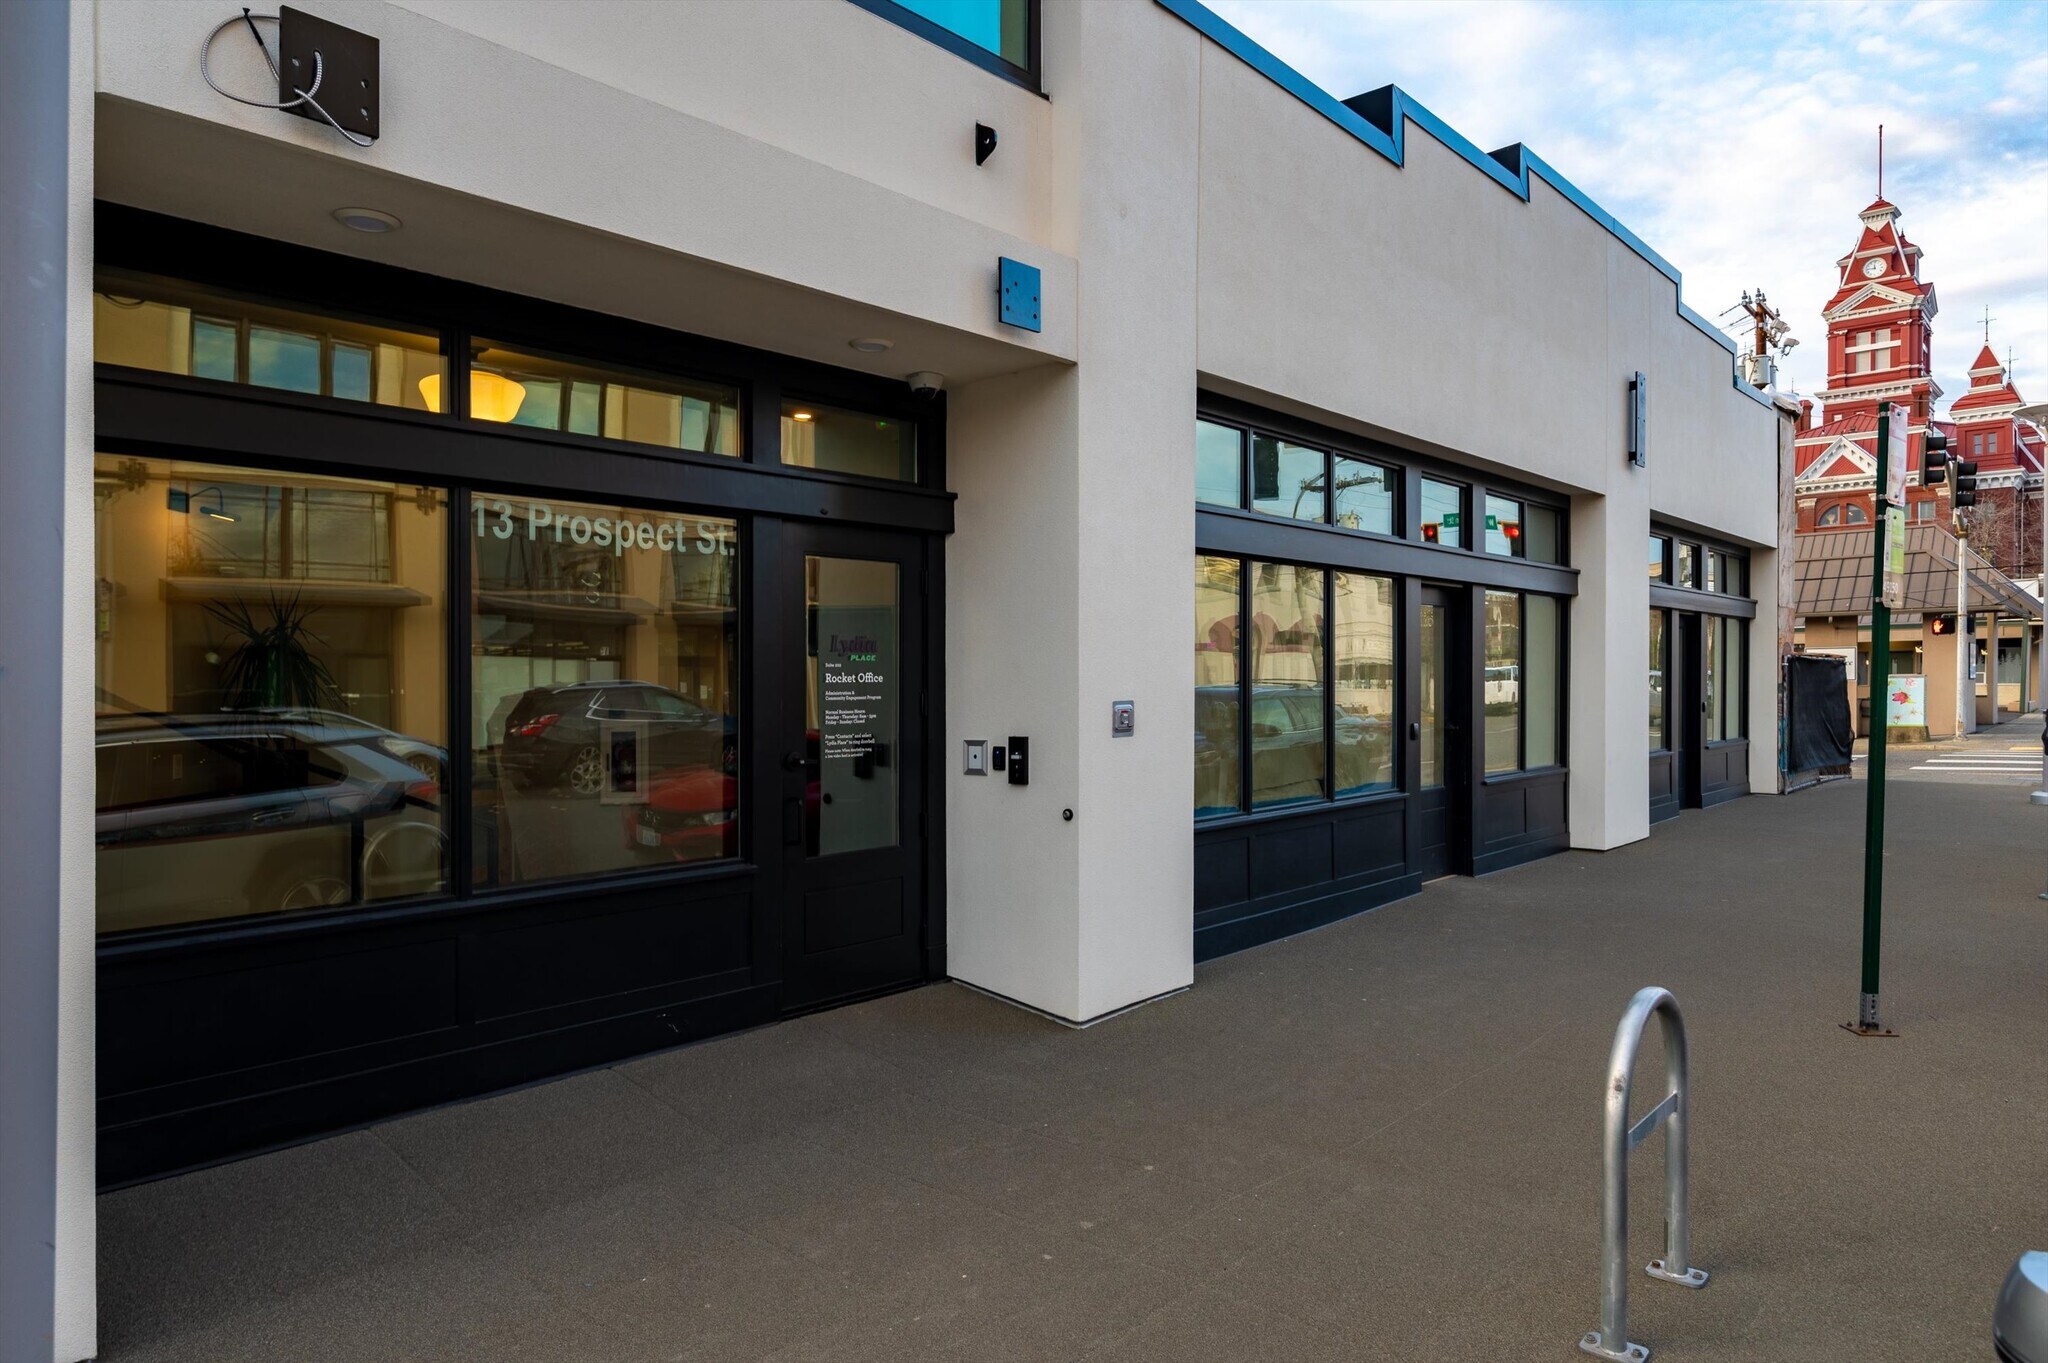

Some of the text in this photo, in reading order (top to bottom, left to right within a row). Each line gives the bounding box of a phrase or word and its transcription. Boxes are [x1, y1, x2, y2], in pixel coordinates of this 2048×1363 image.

[528, 503, 687, 557] Prospect
[696, 520, 735, 556] St.
[830, 634, 878, 657] Lydia
[825, 672, 884, 683] Rocket Office
